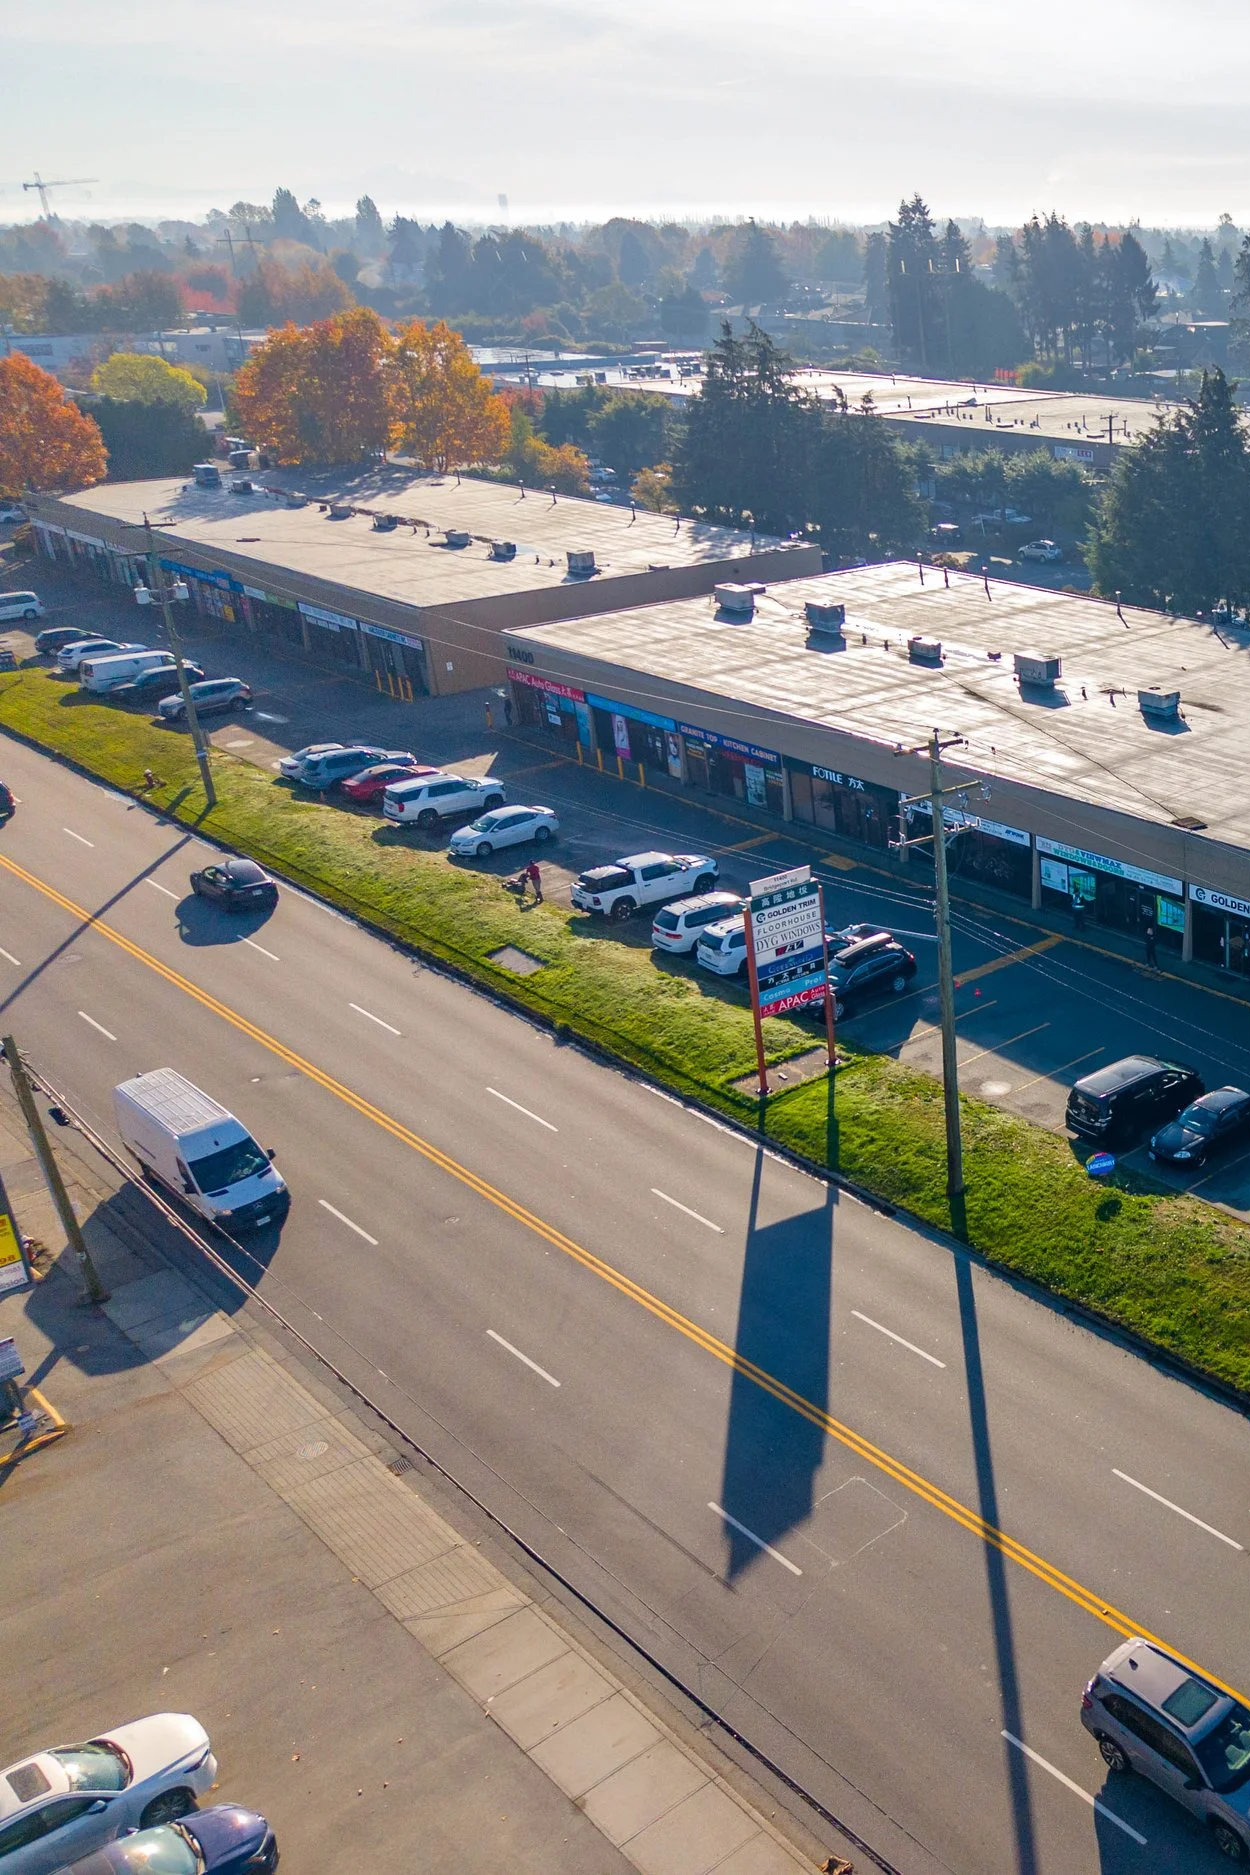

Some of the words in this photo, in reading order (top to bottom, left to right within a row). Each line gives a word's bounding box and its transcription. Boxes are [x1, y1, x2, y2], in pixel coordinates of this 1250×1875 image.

[723, 739, 749, 753] KITCHEN
[751, 748, 777, 762] CABINET
[813, 766, 843, 784] FOTILE
[848, 777, 865, 791] 方太
[767, 905, 797, 918] GOLDEN
[798, 899, 816, 909] TRIM
[1211, 894, 1250, 914] GOLDEN
[757, 911, 817, 936] FLOORHOUSE
[756, 935, 778, 951] DYG
[780, 922, 820, 941] WINDOWS
[763, 988, 791, 1001] Cosmo
[778, 991, 809, 1012] APAC
